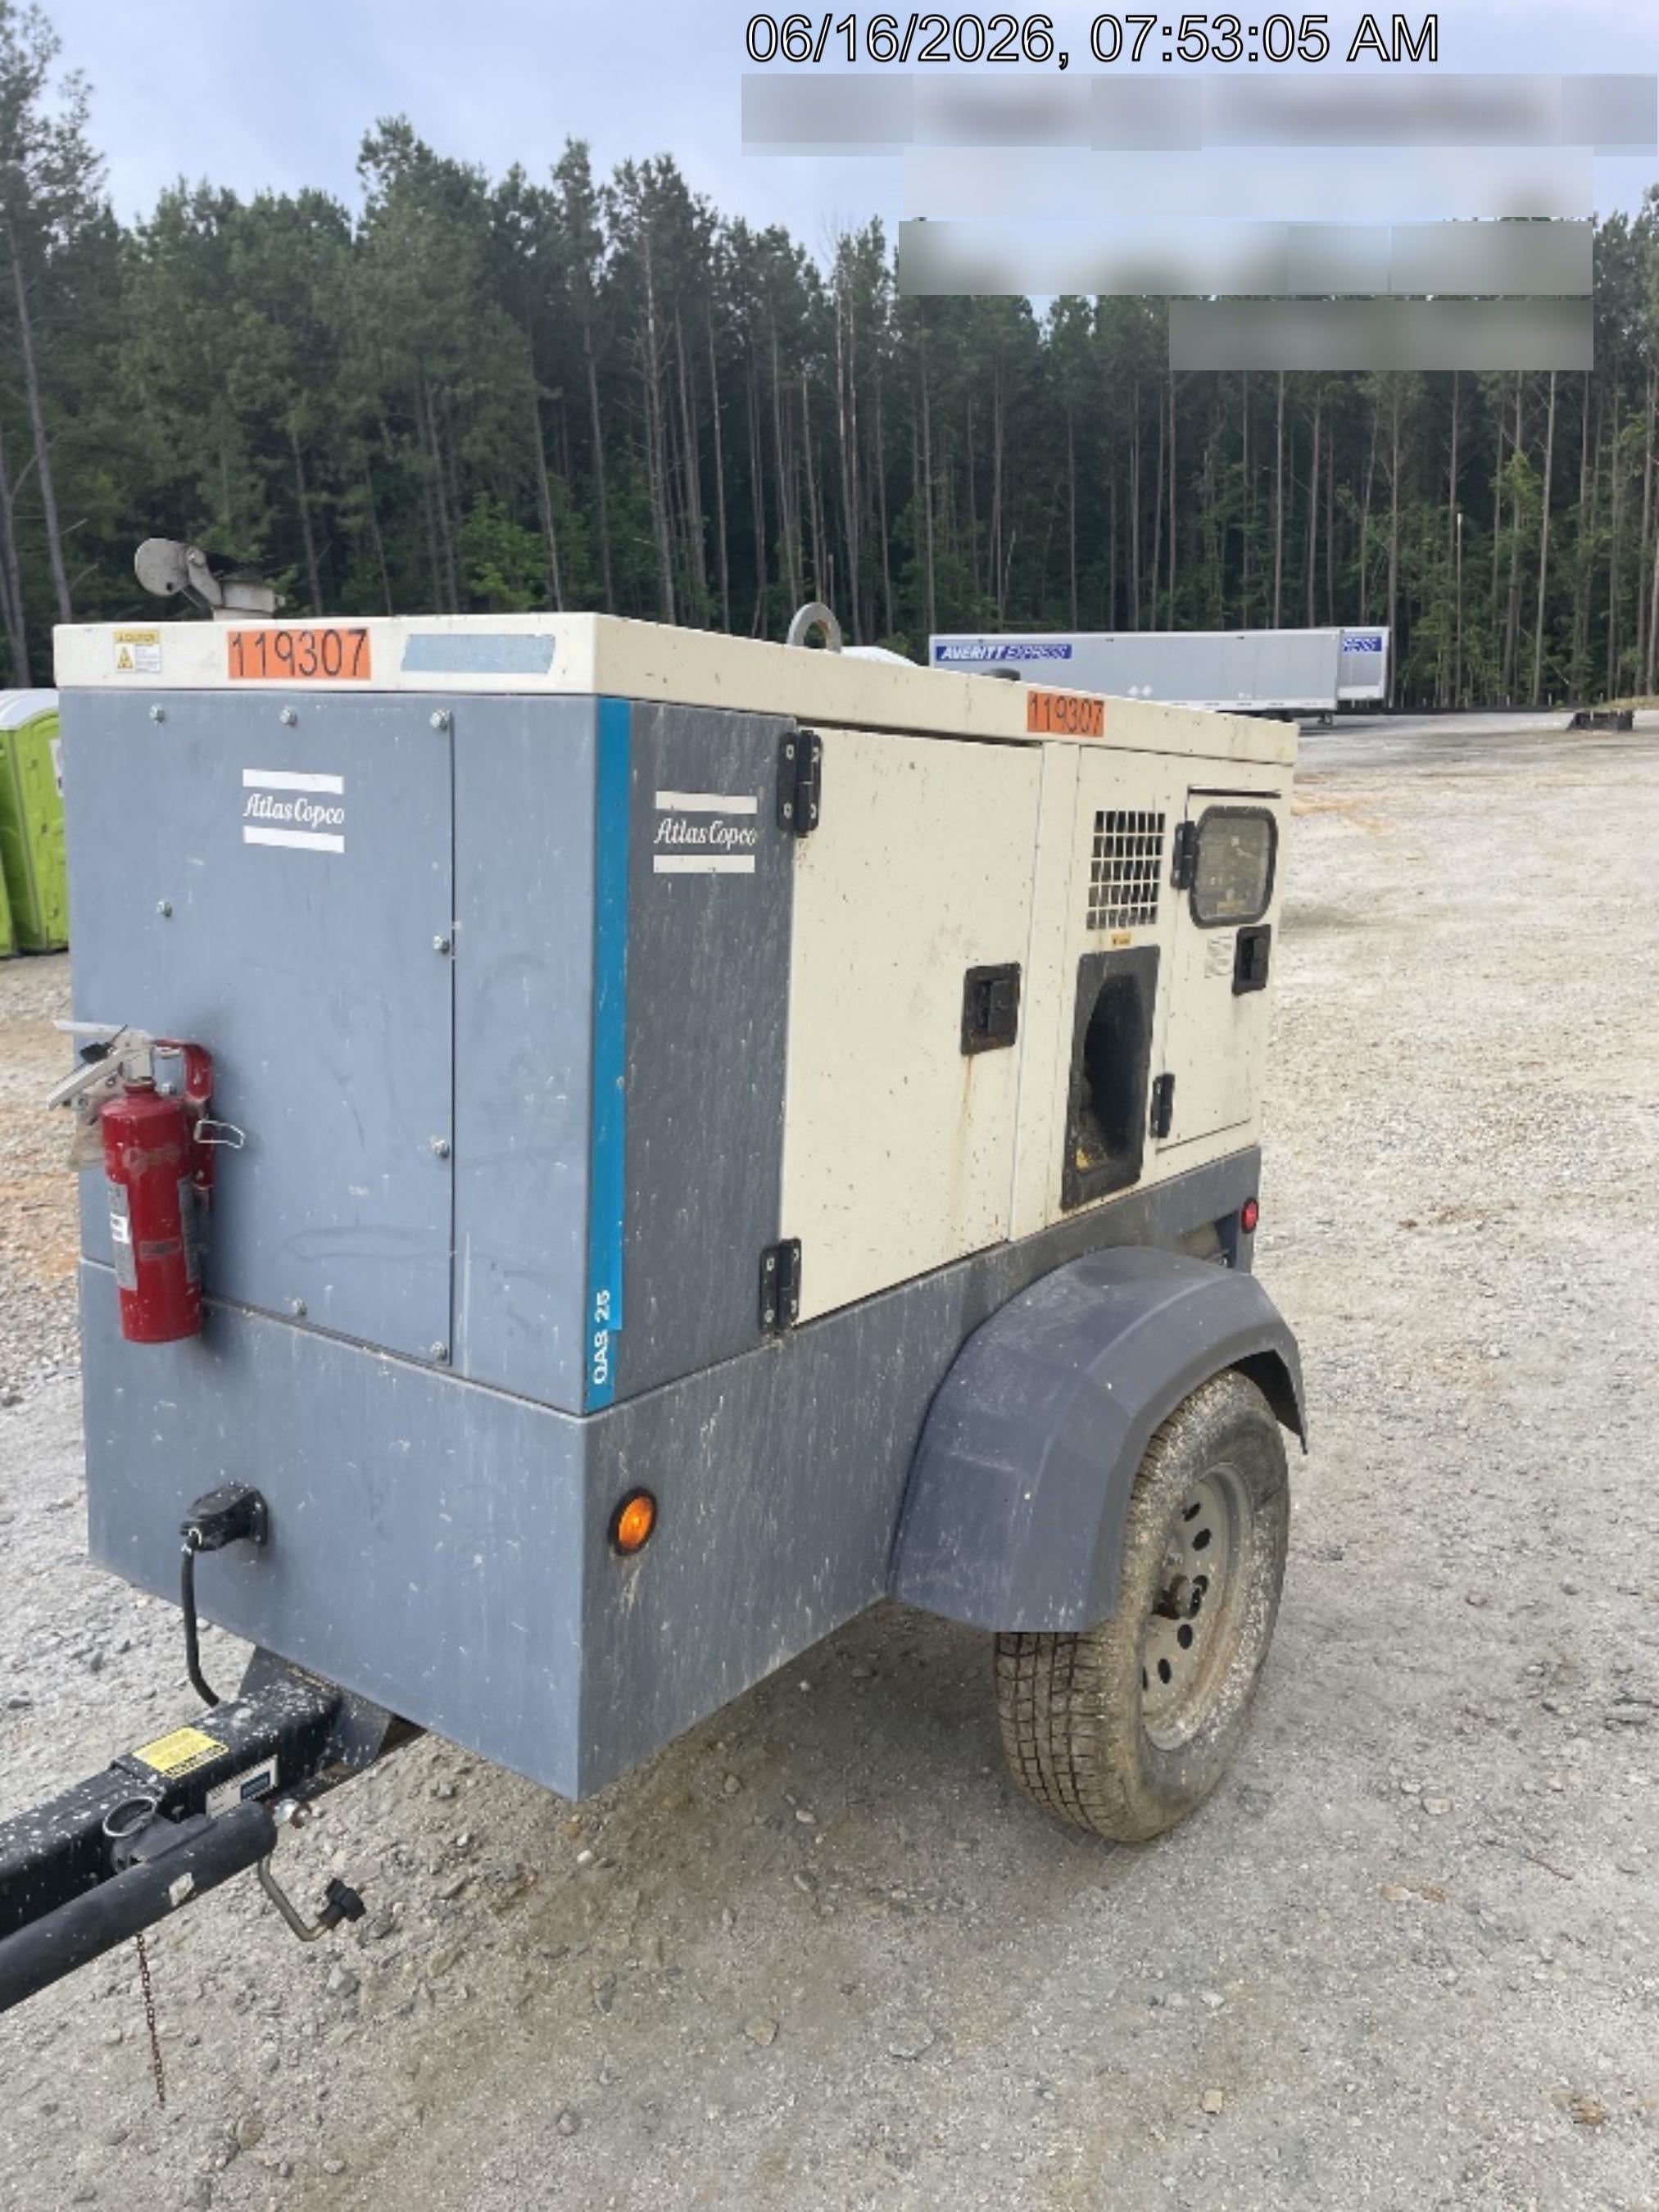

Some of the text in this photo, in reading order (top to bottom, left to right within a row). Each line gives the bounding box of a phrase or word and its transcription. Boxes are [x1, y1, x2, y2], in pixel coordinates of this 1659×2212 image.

[233, 629, 367, 676] 119307
[941, 646, 1007, 660] AVERITT
[1030, 693, 1104, 736] 119307
[243, 793, 344, 829] Atlas Copco
[653, 818, 706, 845] Atlas
[593, 1290, 610, 1385] QAS 25
